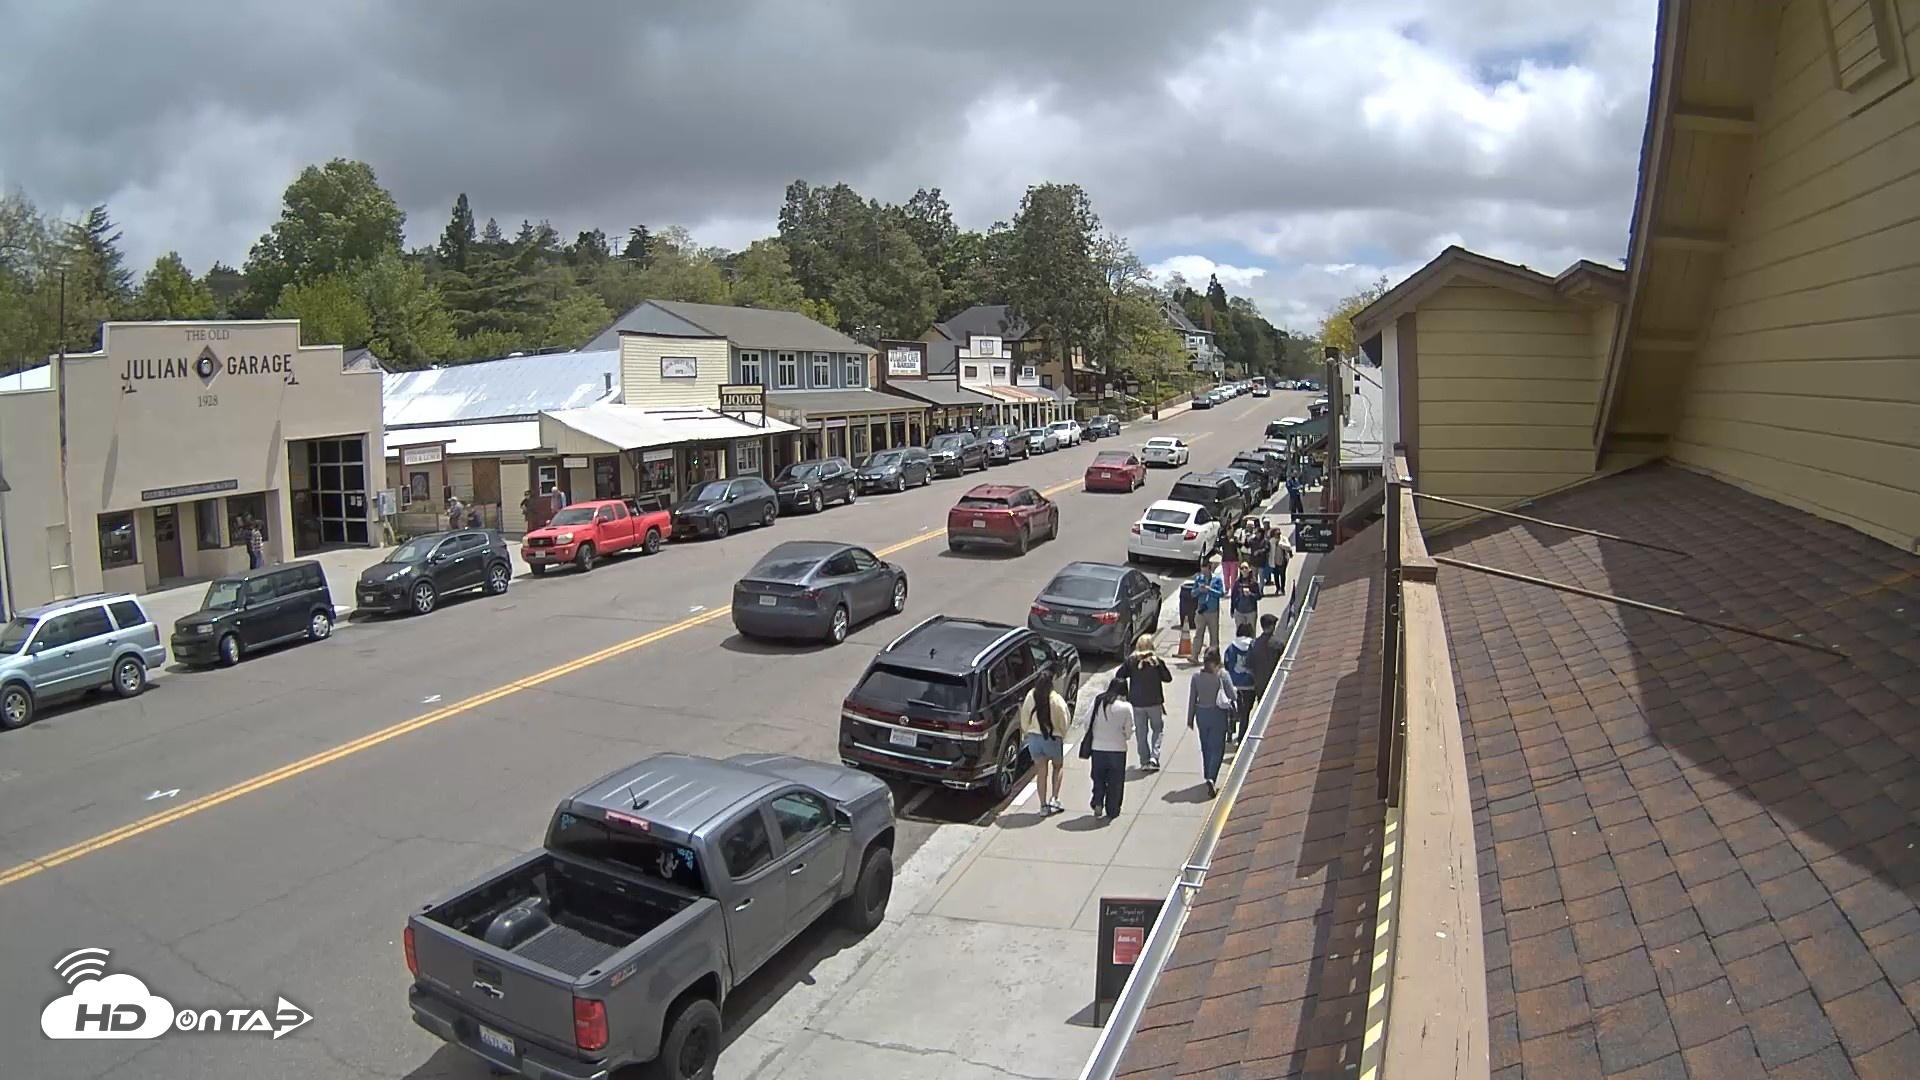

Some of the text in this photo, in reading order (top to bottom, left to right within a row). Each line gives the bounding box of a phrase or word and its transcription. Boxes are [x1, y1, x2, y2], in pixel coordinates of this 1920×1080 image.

[185, 329, 230, 341] THE OLD
[121, 354, 292, 380] JULIAN GARAGE
[198, 394, 219, 407] 1928
[723, 394, 762, 405] LIQUOR
